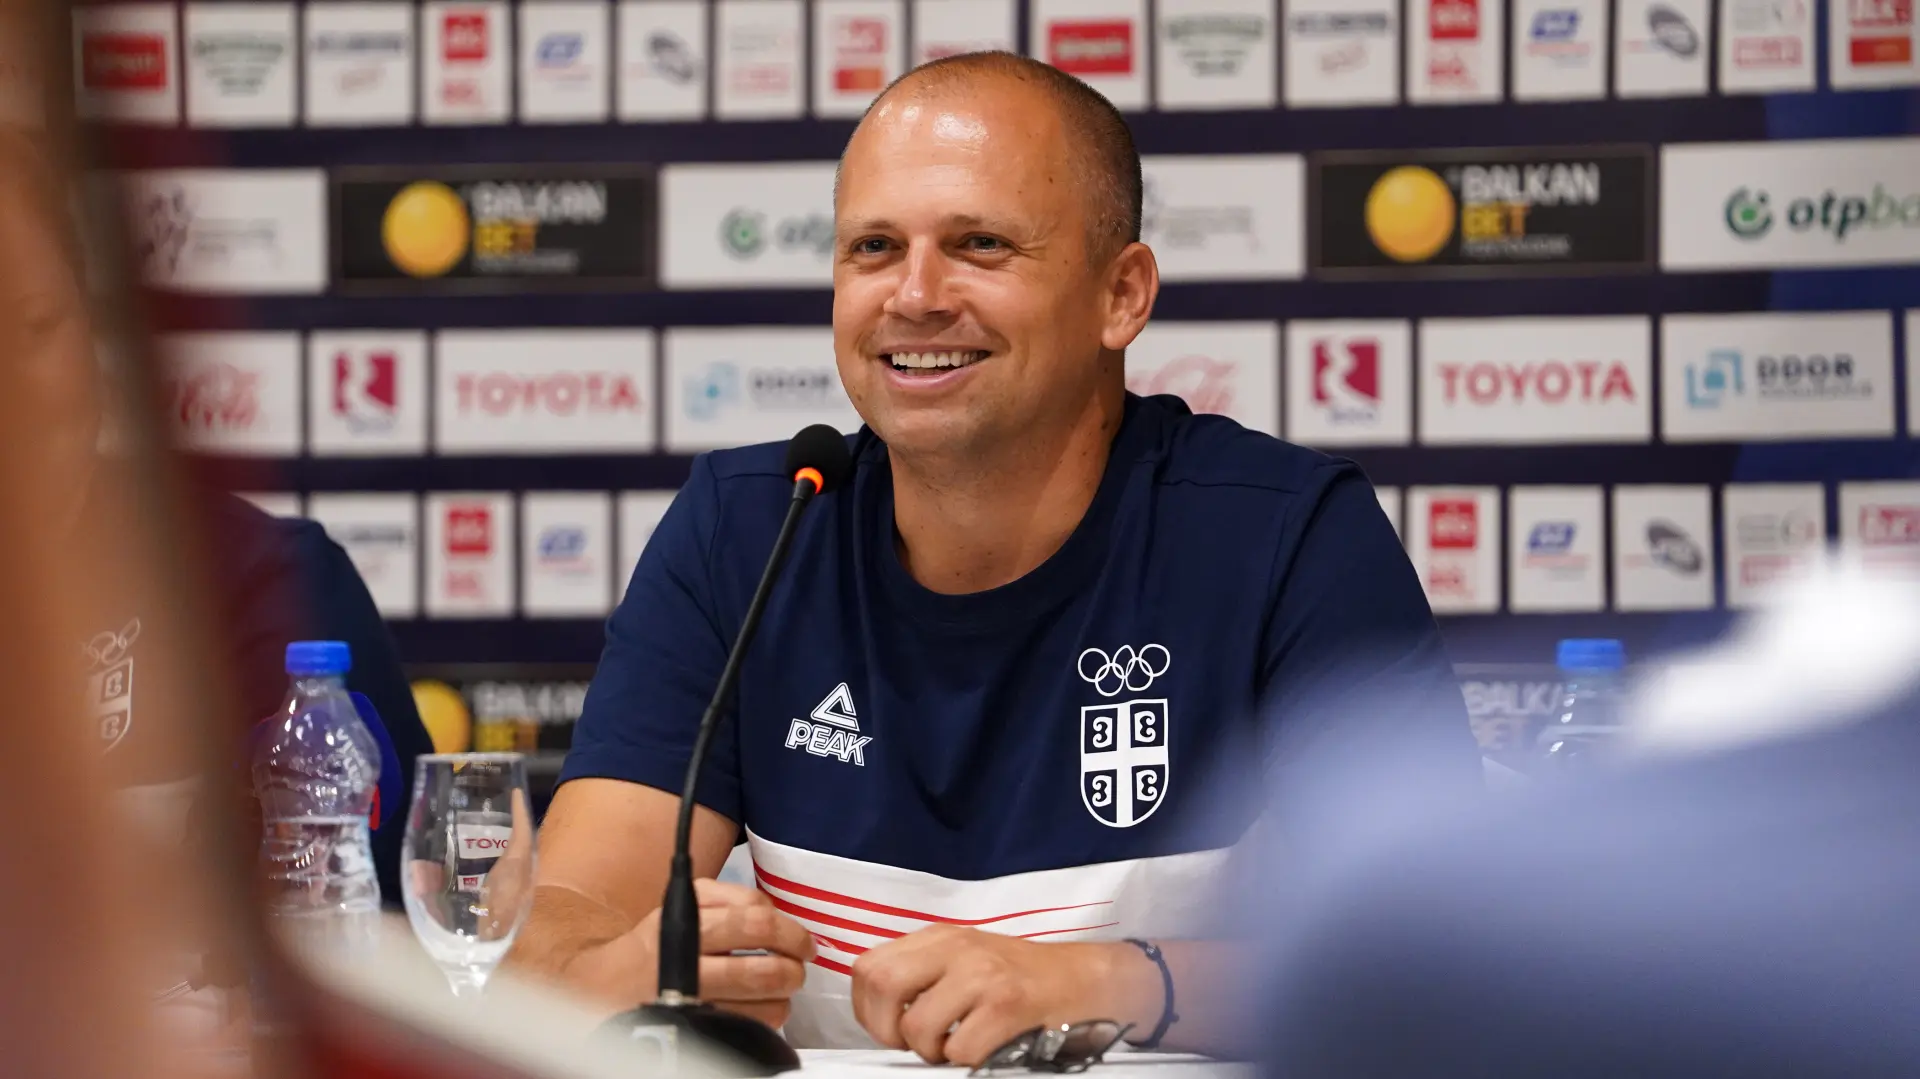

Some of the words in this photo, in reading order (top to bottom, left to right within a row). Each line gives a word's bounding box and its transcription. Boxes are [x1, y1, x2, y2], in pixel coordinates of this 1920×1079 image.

[472, 180, 608, 224] BALKAN
[1461, 162, 1600, 206] BALKAN
[472, 218, 538, 260] BET
[1461, 202, 1530, 242] BET
[454, 372, 642, 417] TOYOTA
[1438, 361, 1639, 406] TOYOTA
[785, 718, 873, 766] PEAK
